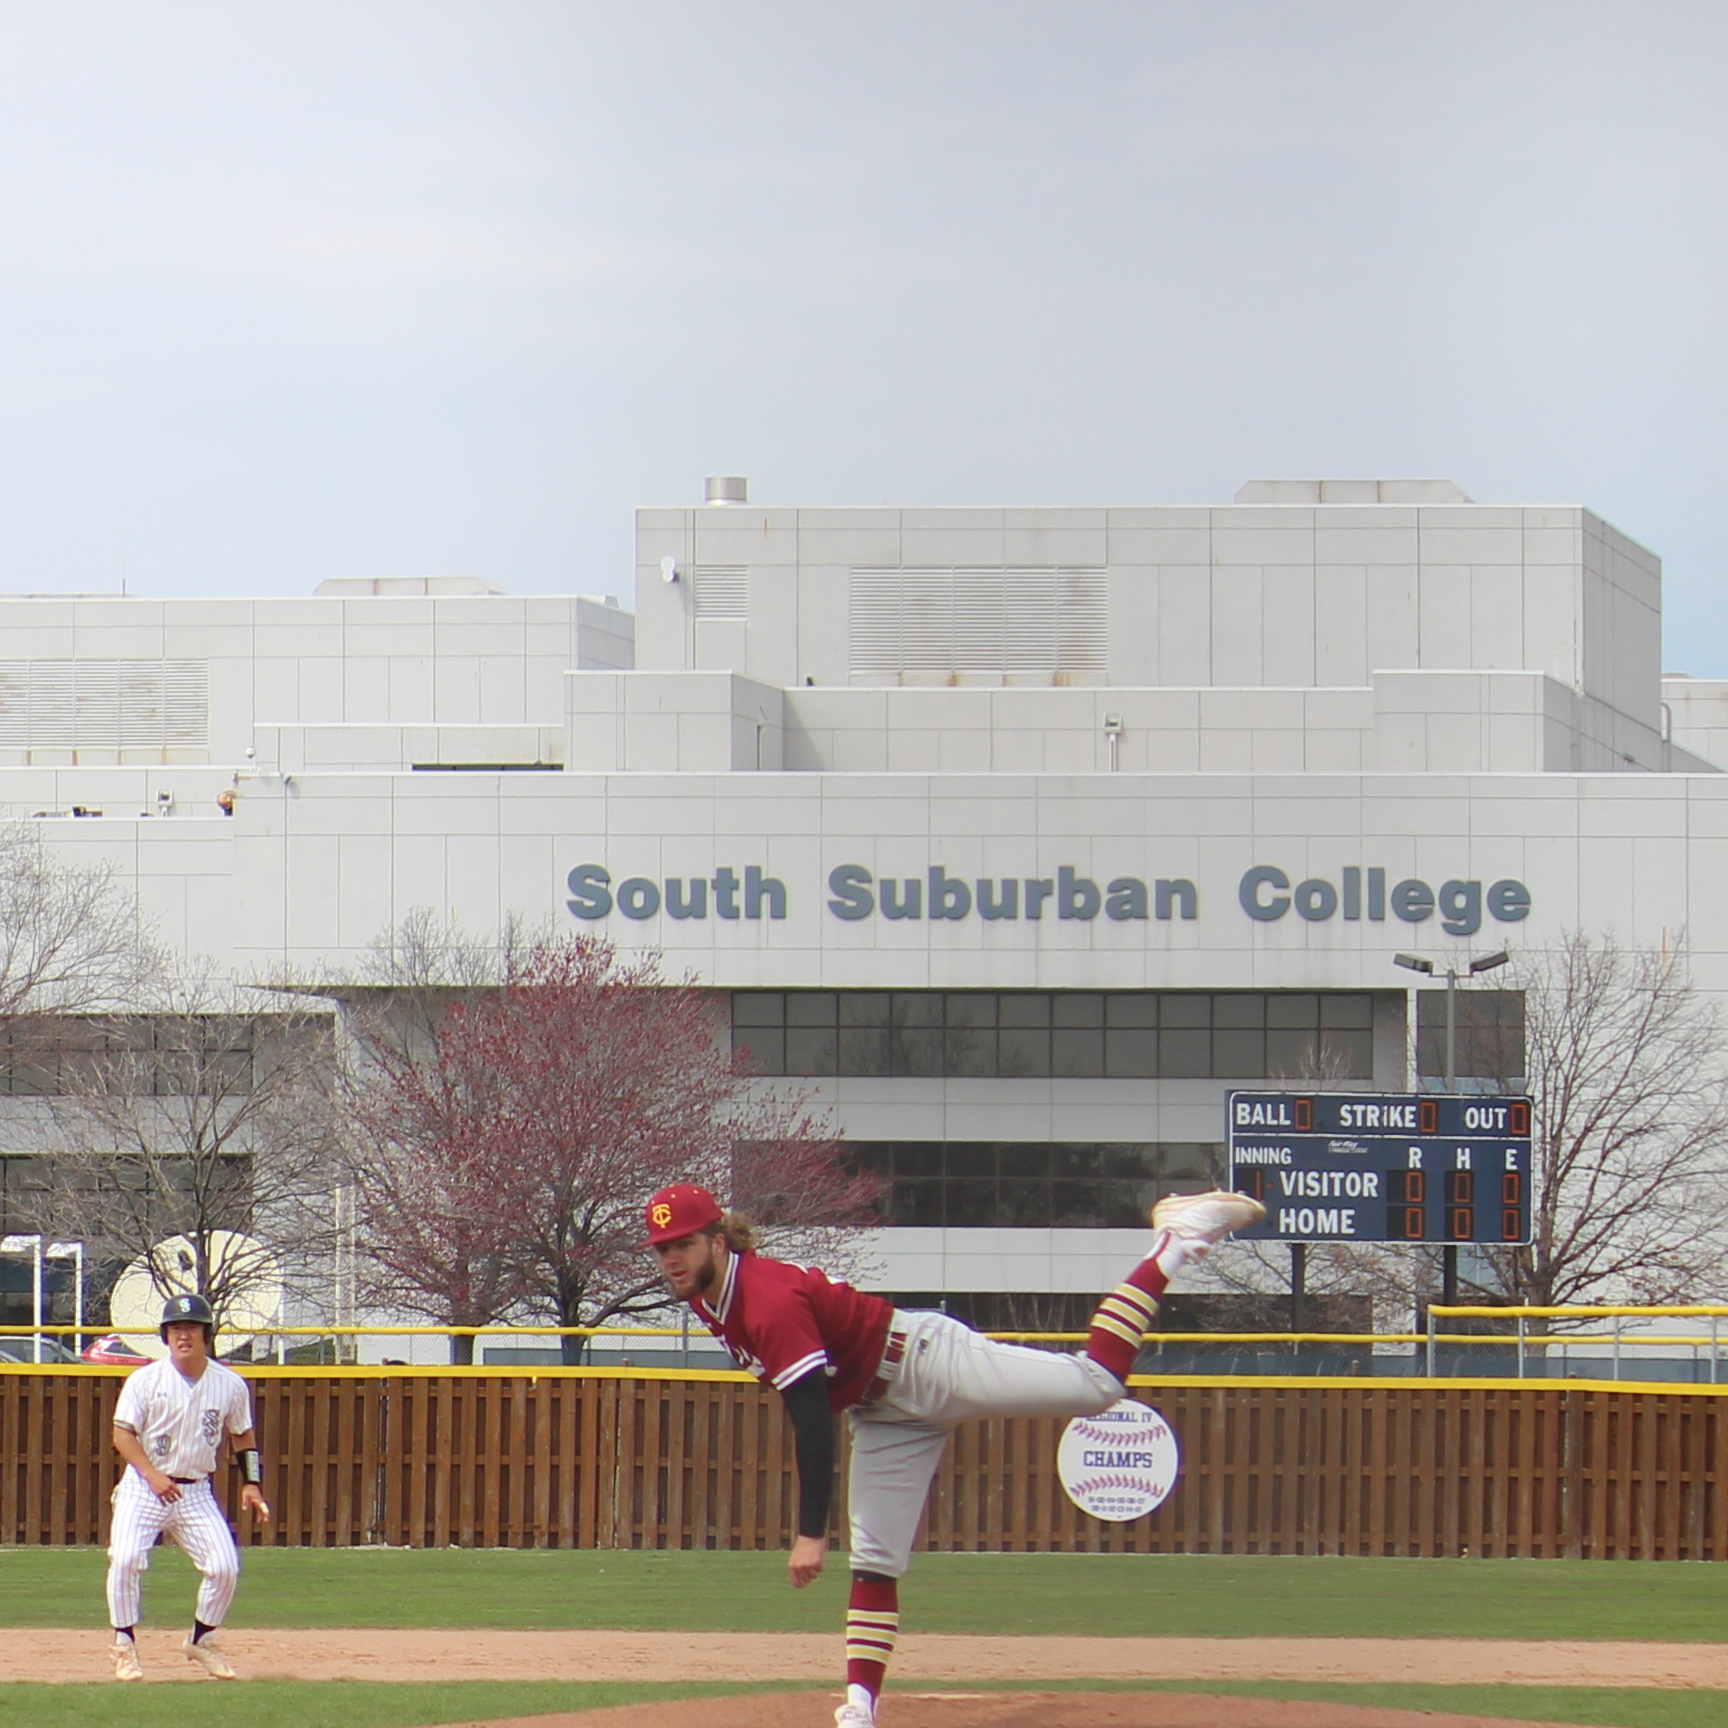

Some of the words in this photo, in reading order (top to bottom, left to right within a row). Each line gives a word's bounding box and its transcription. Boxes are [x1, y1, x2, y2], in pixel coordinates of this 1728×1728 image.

[566, 863, 787, 920] South
[827, 864, 1198, 921] Suburban
[1237, 865, 1531, 935] College
[1236, 1103, 1291, 1126] BALL
[1339, 1104, 1417, 1128] STRIKE
[1465, 1107, 1507, 1129] OUT
[1235, 1146, 1292, 1164] INNING
[1408, 1146, 1422, 1168] R
[1456, 1147, 1471, 1169] H
[1505, 1148, 1518, 1170] E
[1279, 1170, 1379, 1198] VISITOR
[1279, 1208, 1356, 1235] HOME
[155, 1434, 171, 1456] 9
[1083, 1450, 1153, 1468] CHAMPS
